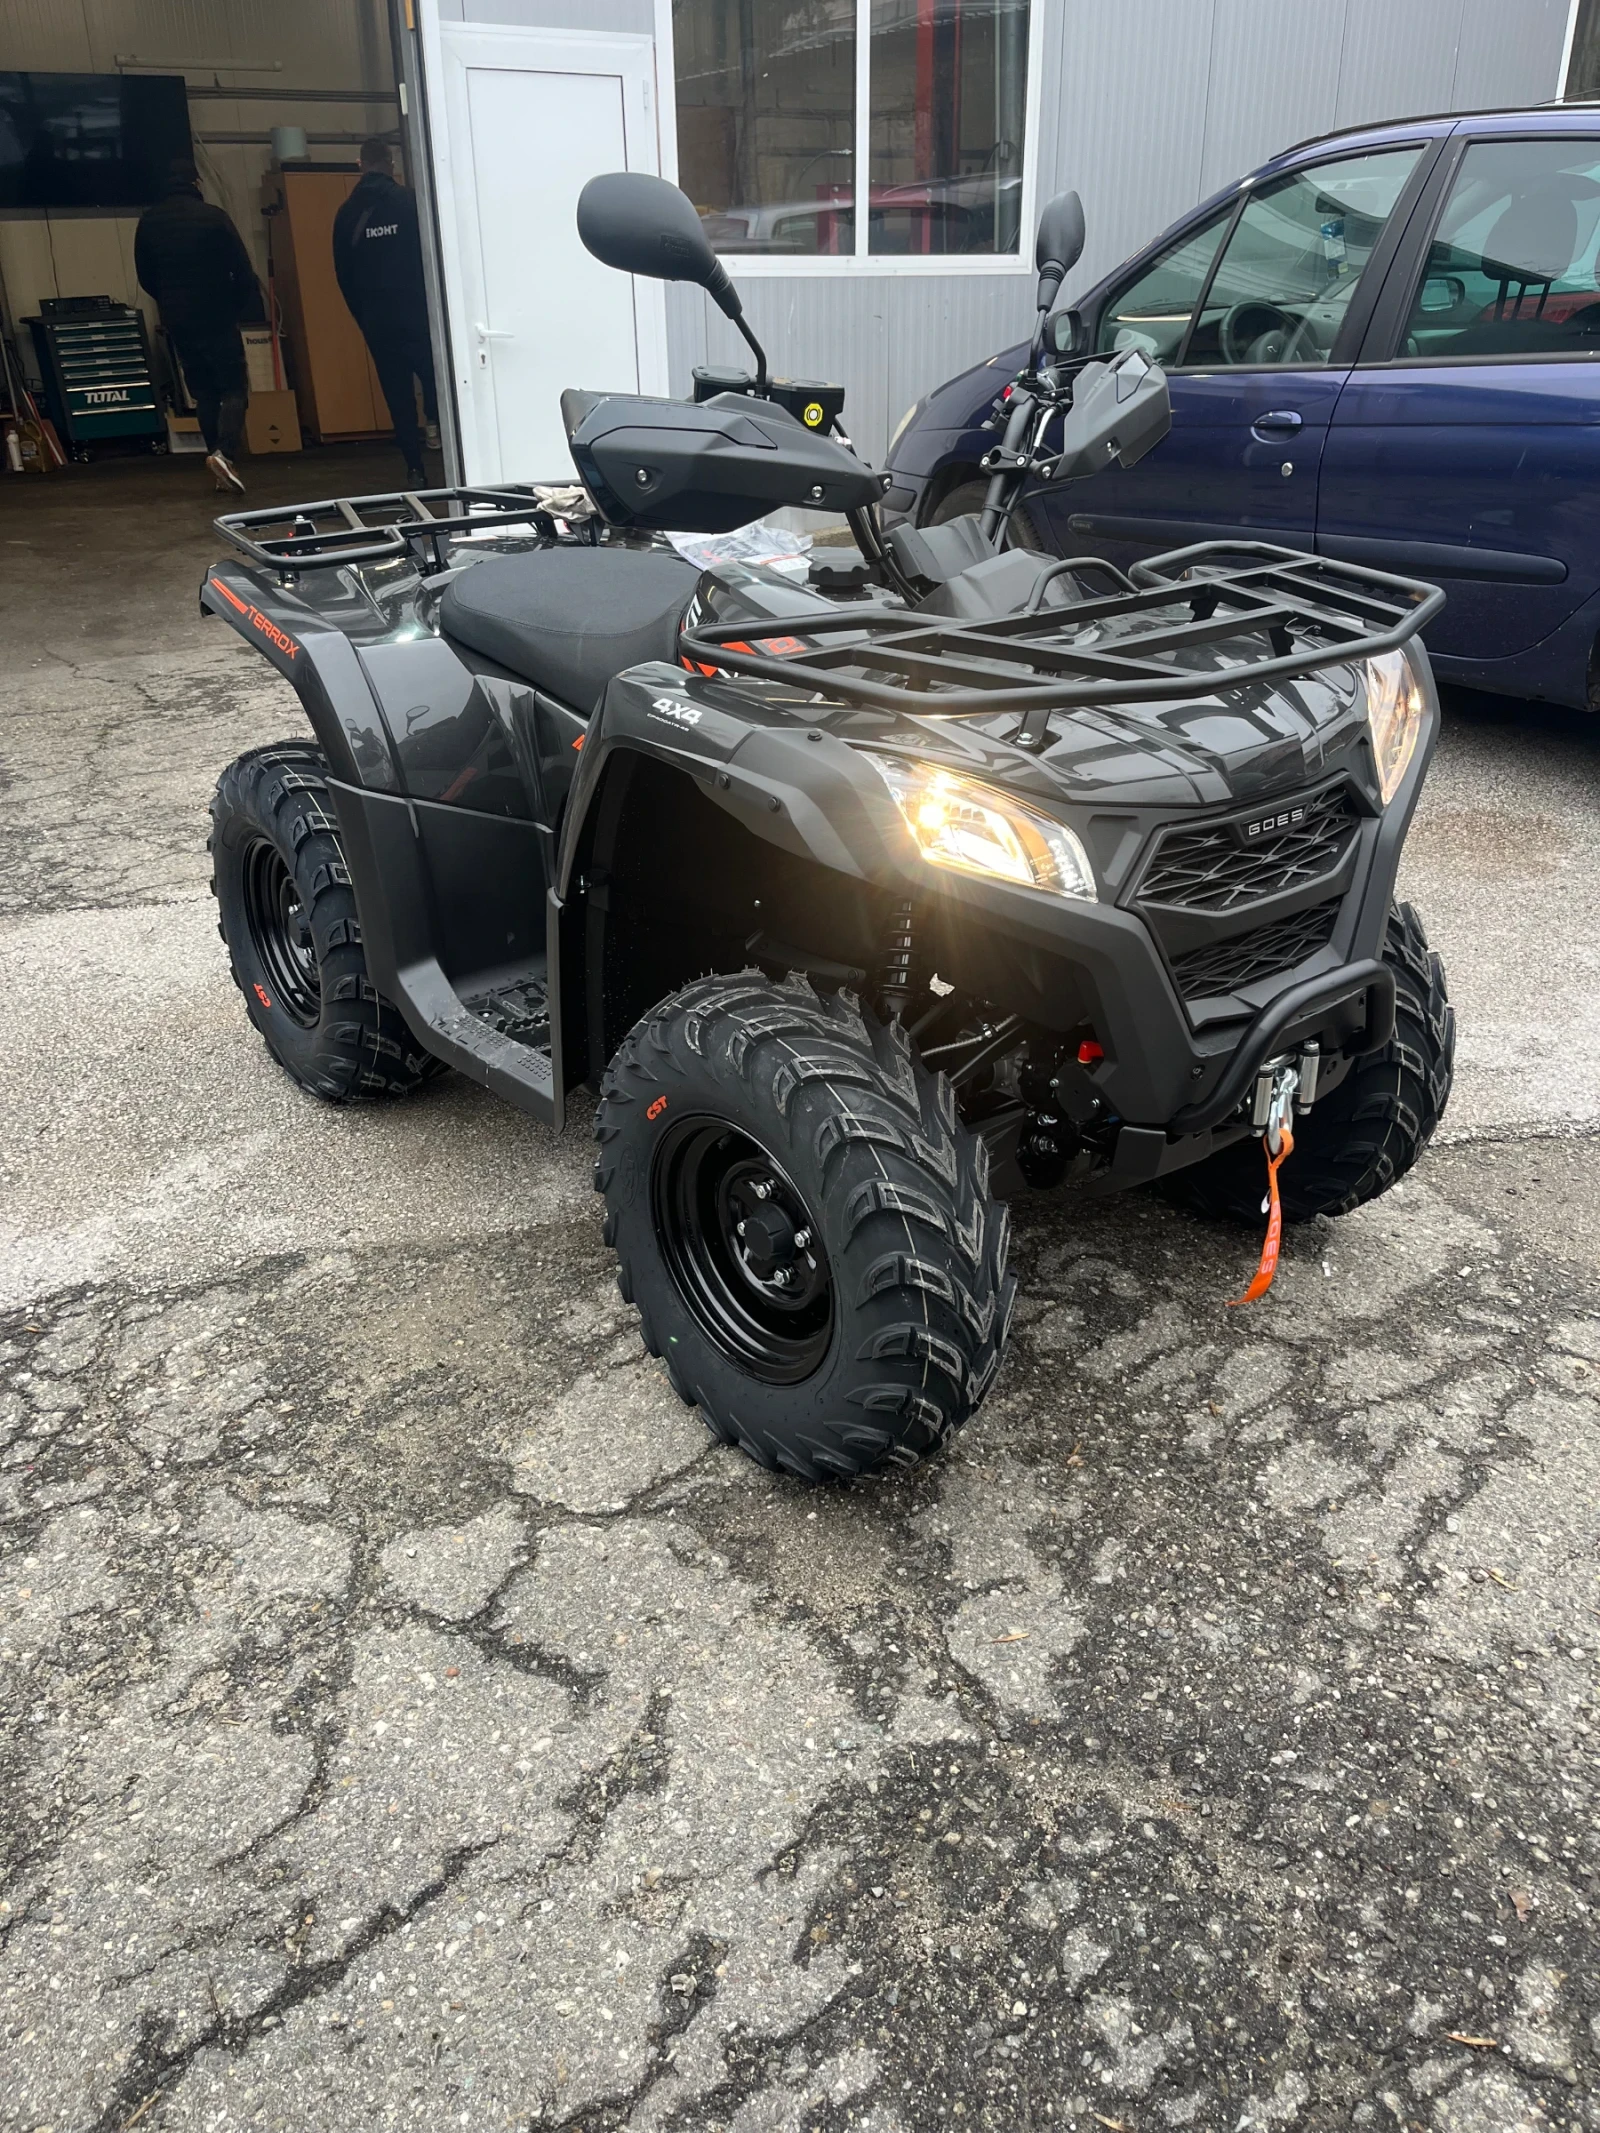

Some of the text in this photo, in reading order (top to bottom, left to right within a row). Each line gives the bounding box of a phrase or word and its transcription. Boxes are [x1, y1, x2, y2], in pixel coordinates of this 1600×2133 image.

[246, 337, 271, 345] hous
[84, 390, 131, 404] TOTAL
[248, 605, 300, 660] TERROX
[1248, 808, 1303, 836] GOES
[253, 983, 271, 1008] CST
[646, 1095, 668, 1120] CST
